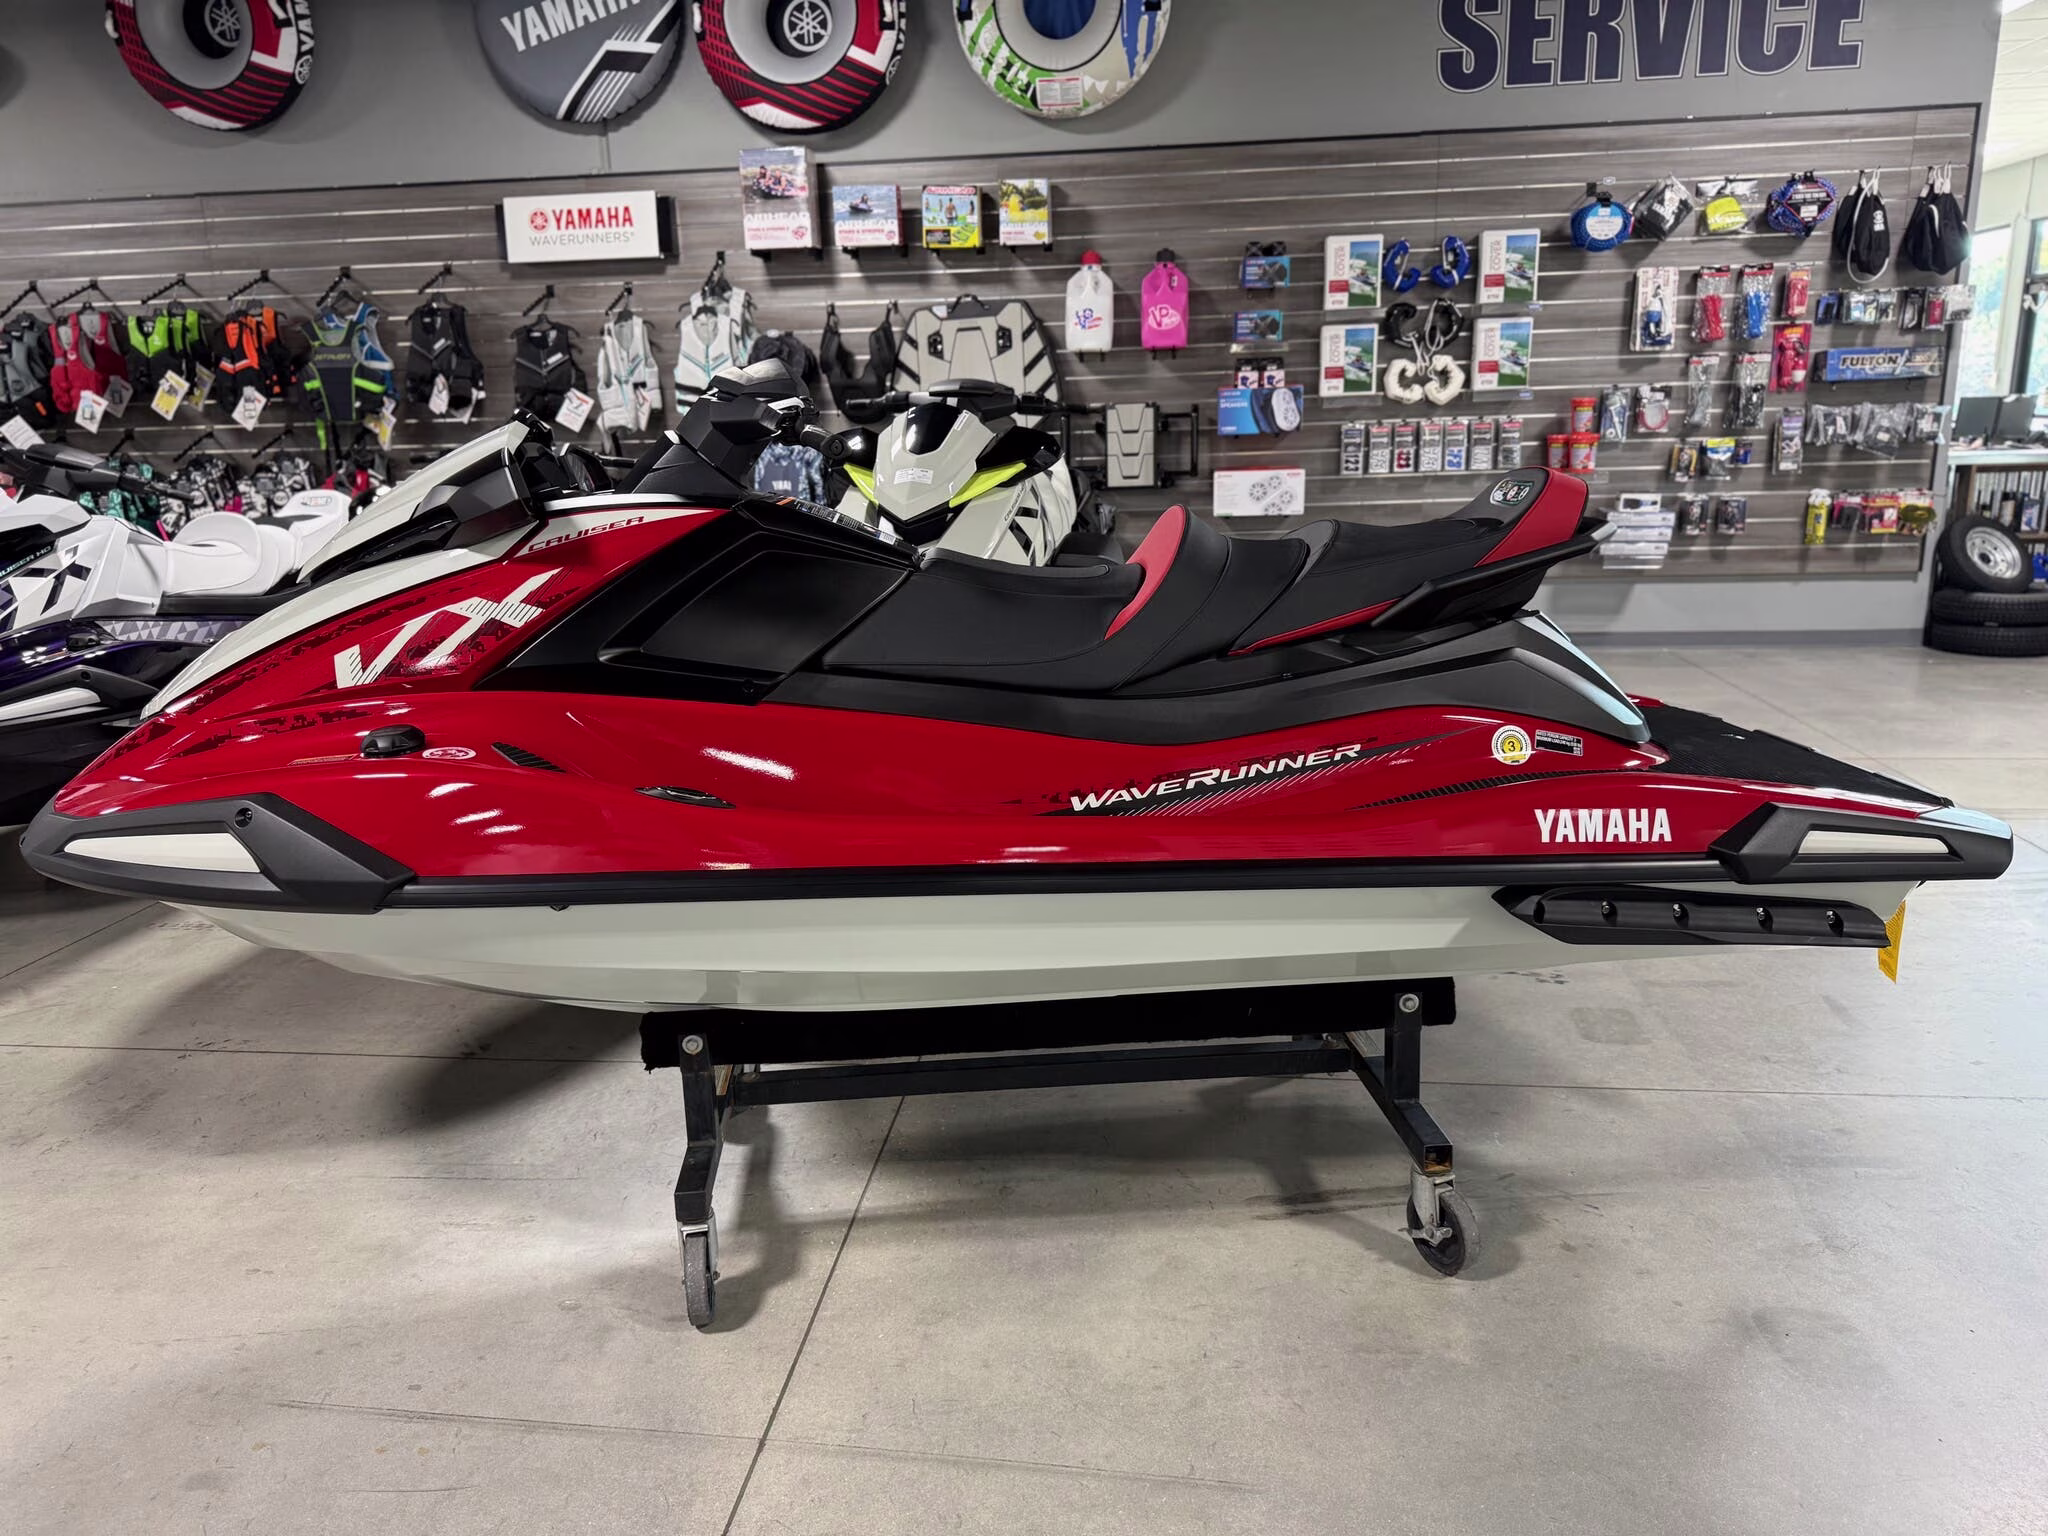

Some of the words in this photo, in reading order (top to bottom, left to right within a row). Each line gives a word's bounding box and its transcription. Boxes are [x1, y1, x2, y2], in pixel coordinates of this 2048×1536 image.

[500, 0, 642, 52] YAMA
[1437, 0, 1863, 93] SERVICE
[552, 206, 634, 231] YAMAHA
[1840, 354, 1901, 367] FULTON
[527, 516, 646, 553] CRUISER
[1507, 740, 1517, 752] 3
[1534, 808, 1673, 843] YAMAHA
